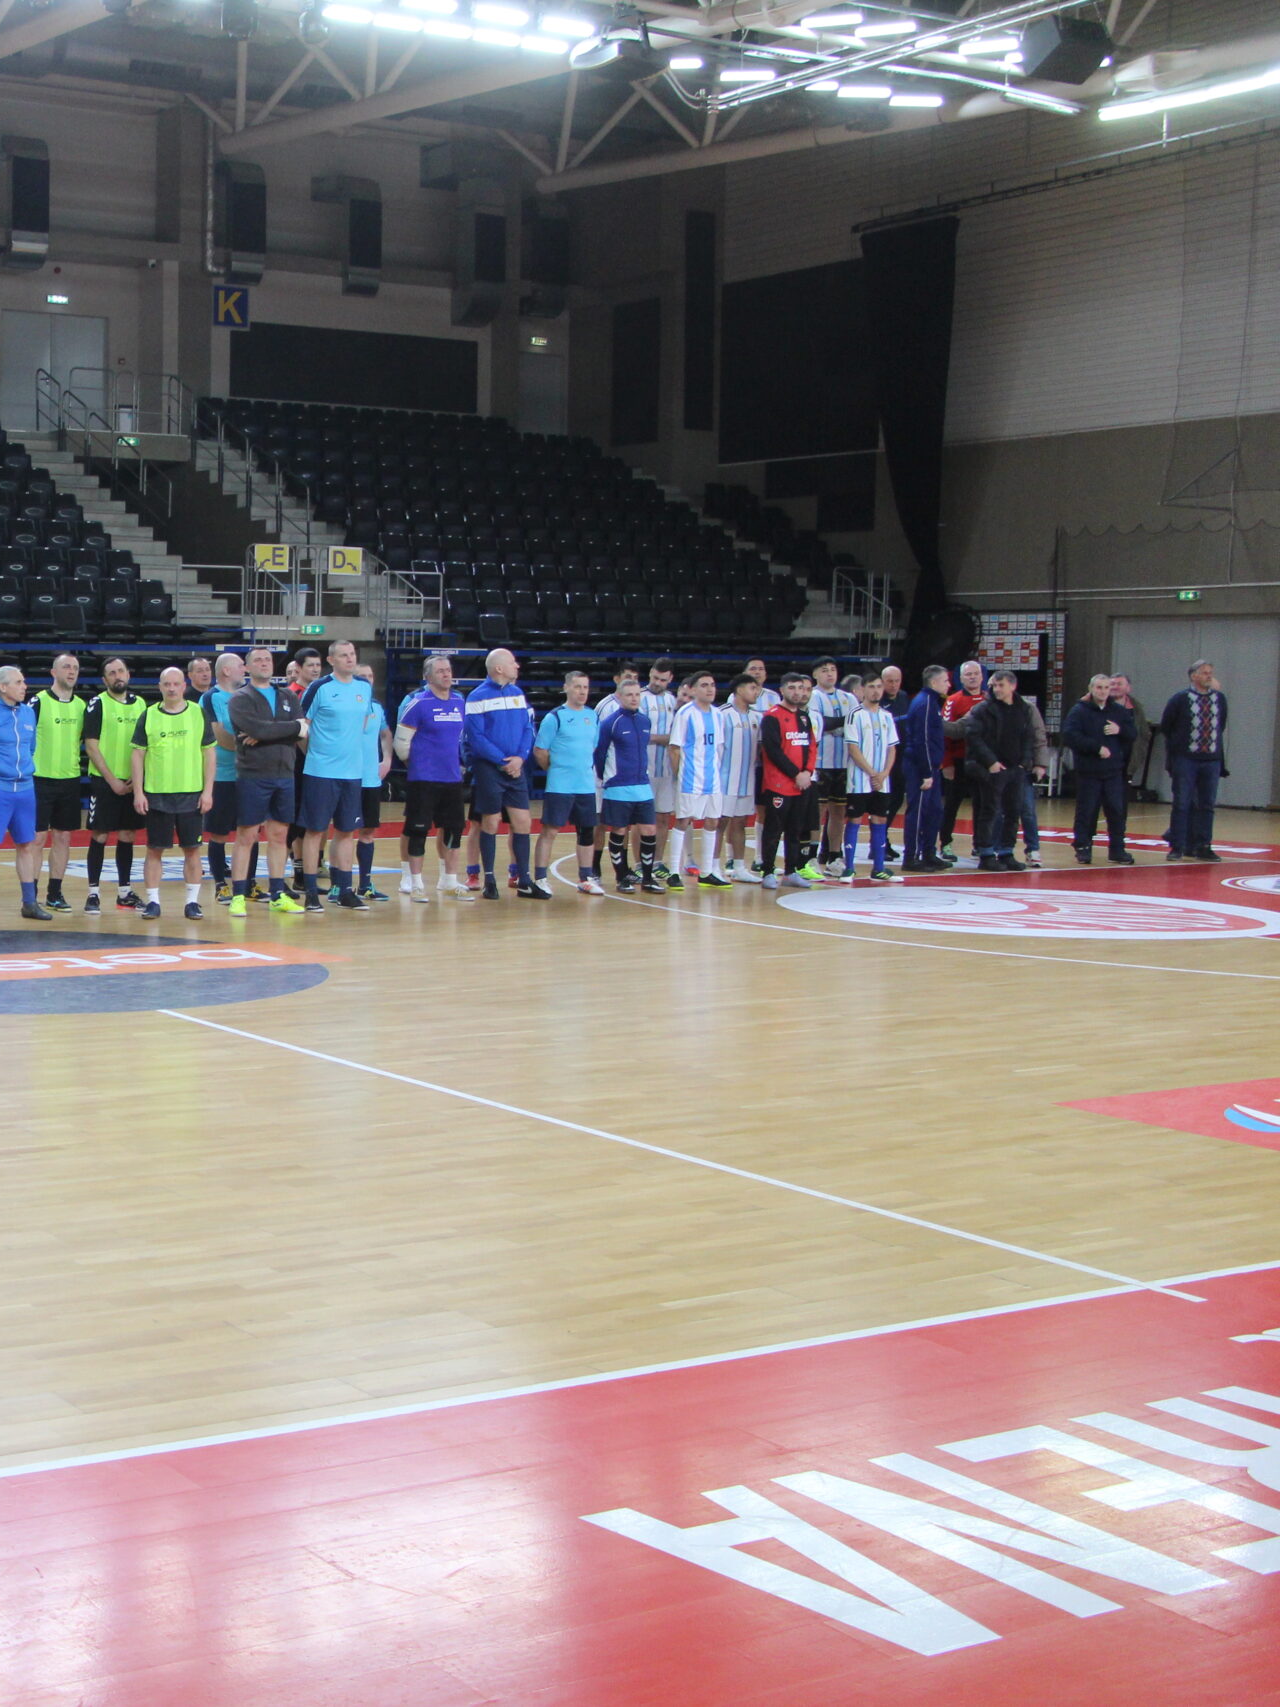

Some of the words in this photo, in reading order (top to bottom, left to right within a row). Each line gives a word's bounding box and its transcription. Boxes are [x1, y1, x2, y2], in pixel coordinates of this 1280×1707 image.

[218, 289, 243, 324] K
[271, 546, 284, 566] E
[333, 550, 346, 569] D
[704, 733, 715, 746] 10
[578, 1385, 1280, 1657] ENA
